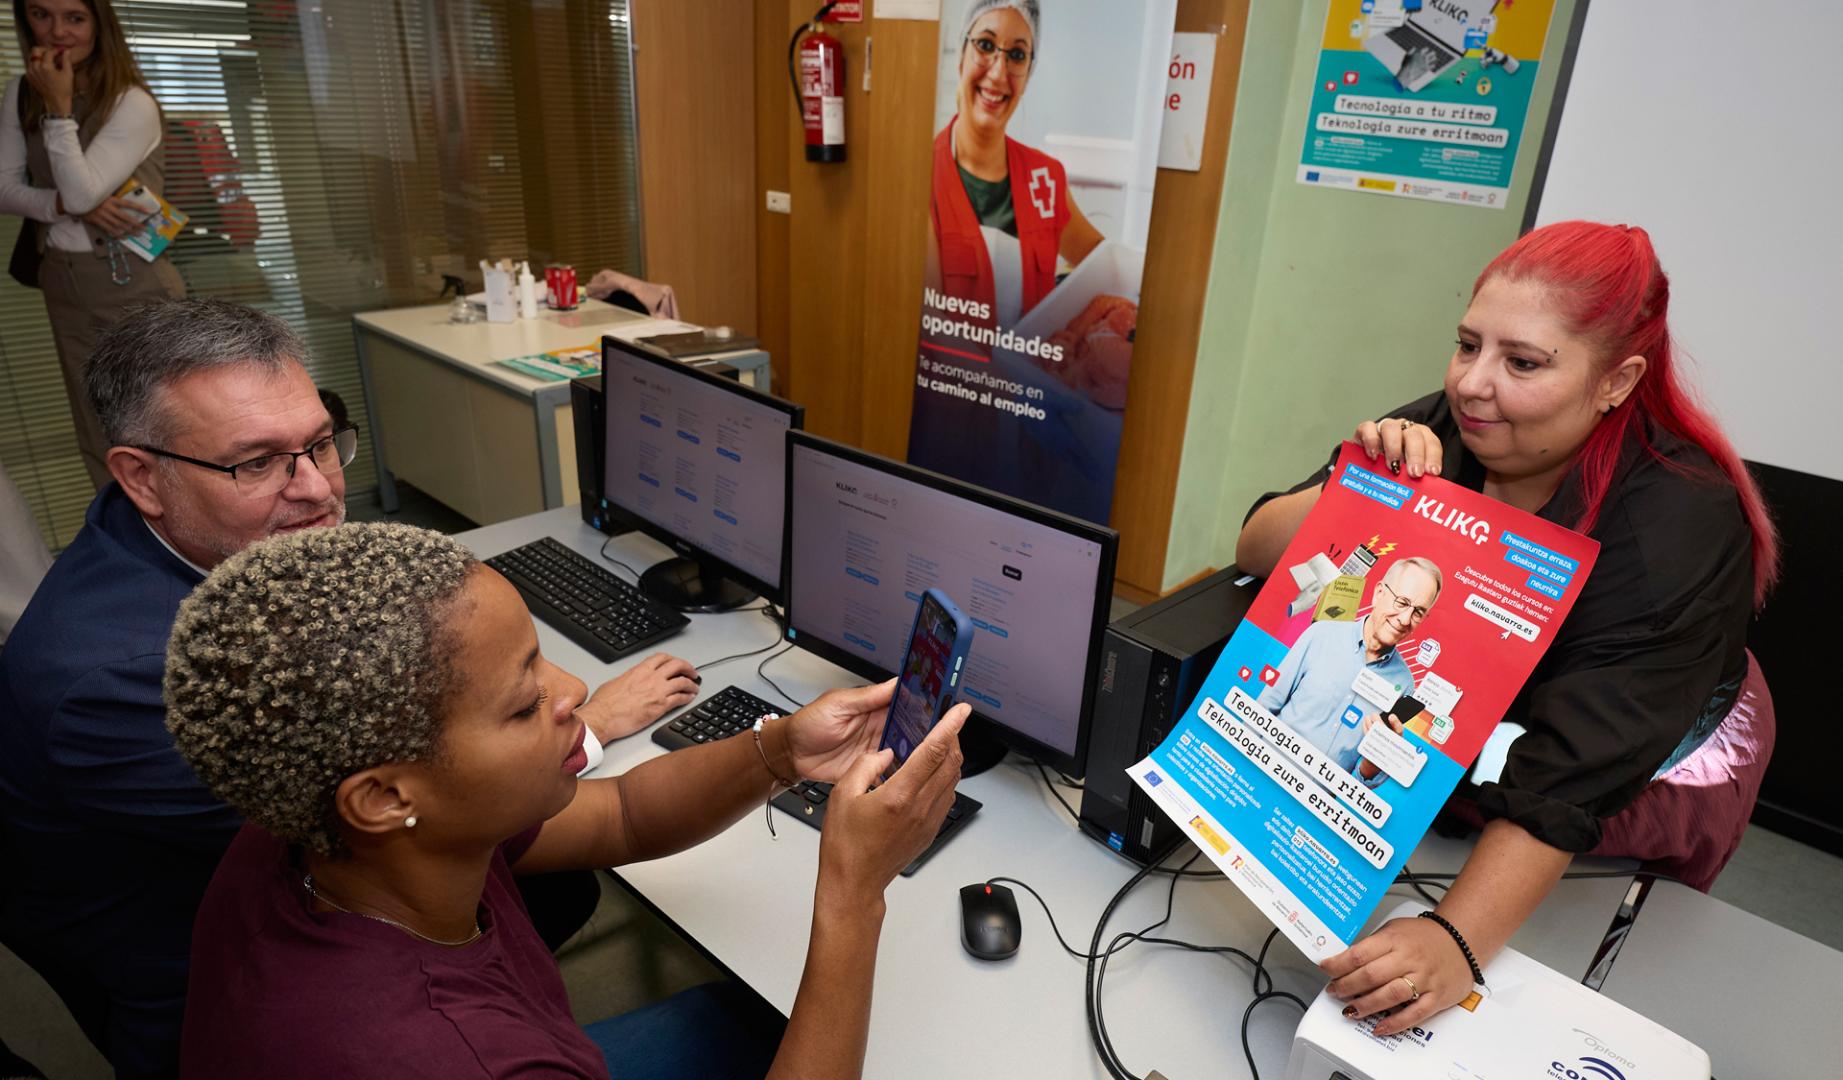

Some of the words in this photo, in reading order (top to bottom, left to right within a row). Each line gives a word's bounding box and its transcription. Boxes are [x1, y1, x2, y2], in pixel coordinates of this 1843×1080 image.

[1417, 107, 1424, 115] a
[1431, 106, 1445, 118] tu
[1451, 107, 1491, 122] ritmo
[1397, 125, 1426, 136] zure
[1432, 128, 1503, 143] erritmoan
[924, 287, 990, 320] Nuevas
[922, 314, 1064, 362] oportunidades
[919, 354, 929, 371] Te
[932, 360, 1023, 395] acompañamos
[1026, 387, 1043, 399] en
[917, 374, 928, 387] tu
[931, 381, 977, 401] camino
[980, 391, 991, 405] al
[995, 396, 1046, 420] empleo
[1504, 534, 1549, 558] Prestakuntza
[1511, 553, 1537, 569] doakoa
[1537, 565, 1549, 574] eta
[1549, 571, 1566, 582] zure
[1453, 571, 1478, 588] Ezagutu
[1477, 583, 1502, 599] ikastaro
[1500, 595, 1524, 611] guztiak
[1464, 565, 1493, 584] Descubre
[1493, 579, 1511, 592] todos
[1511, 588, 1521, 597] los
[1520, 594, 1542, 608] cursos
[1530, 579, 1558, 596] neurrira
[1469, 599, 1534, 634] kliko.navarra.es
[1203, 703, 1270, 764] Teknologia
[1273, 764, 1304, 793] zure
[1308, 793, 1385, 861] erritmoan
[1304, 753, 1313, 765] a
[1318, 762, 1335, 782] tu
[1338, 780, 1382, 820] ritmo
[1584, 1037, 1636, 1069] Optoma
